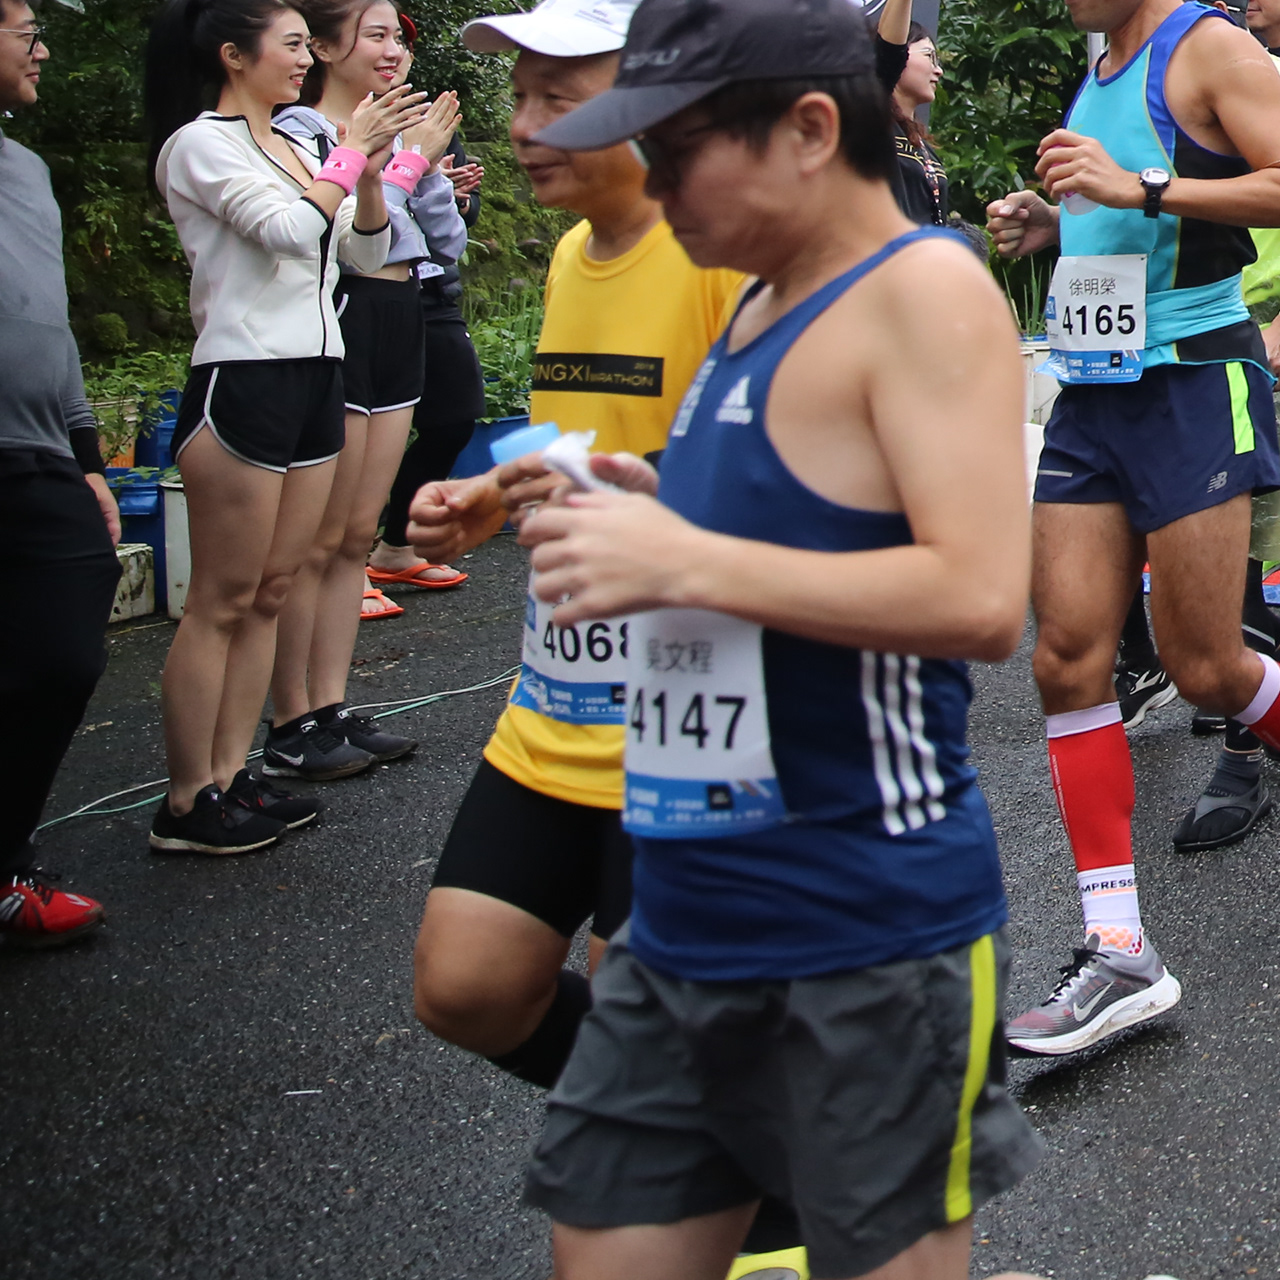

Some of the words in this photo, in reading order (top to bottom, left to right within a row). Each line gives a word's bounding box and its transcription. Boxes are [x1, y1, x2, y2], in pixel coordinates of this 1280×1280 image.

[1068, 277, 1117, 296] 徐明榮
[1062, 304, 1136, 336] 4165
[630, 687, 748, 750] 4147
